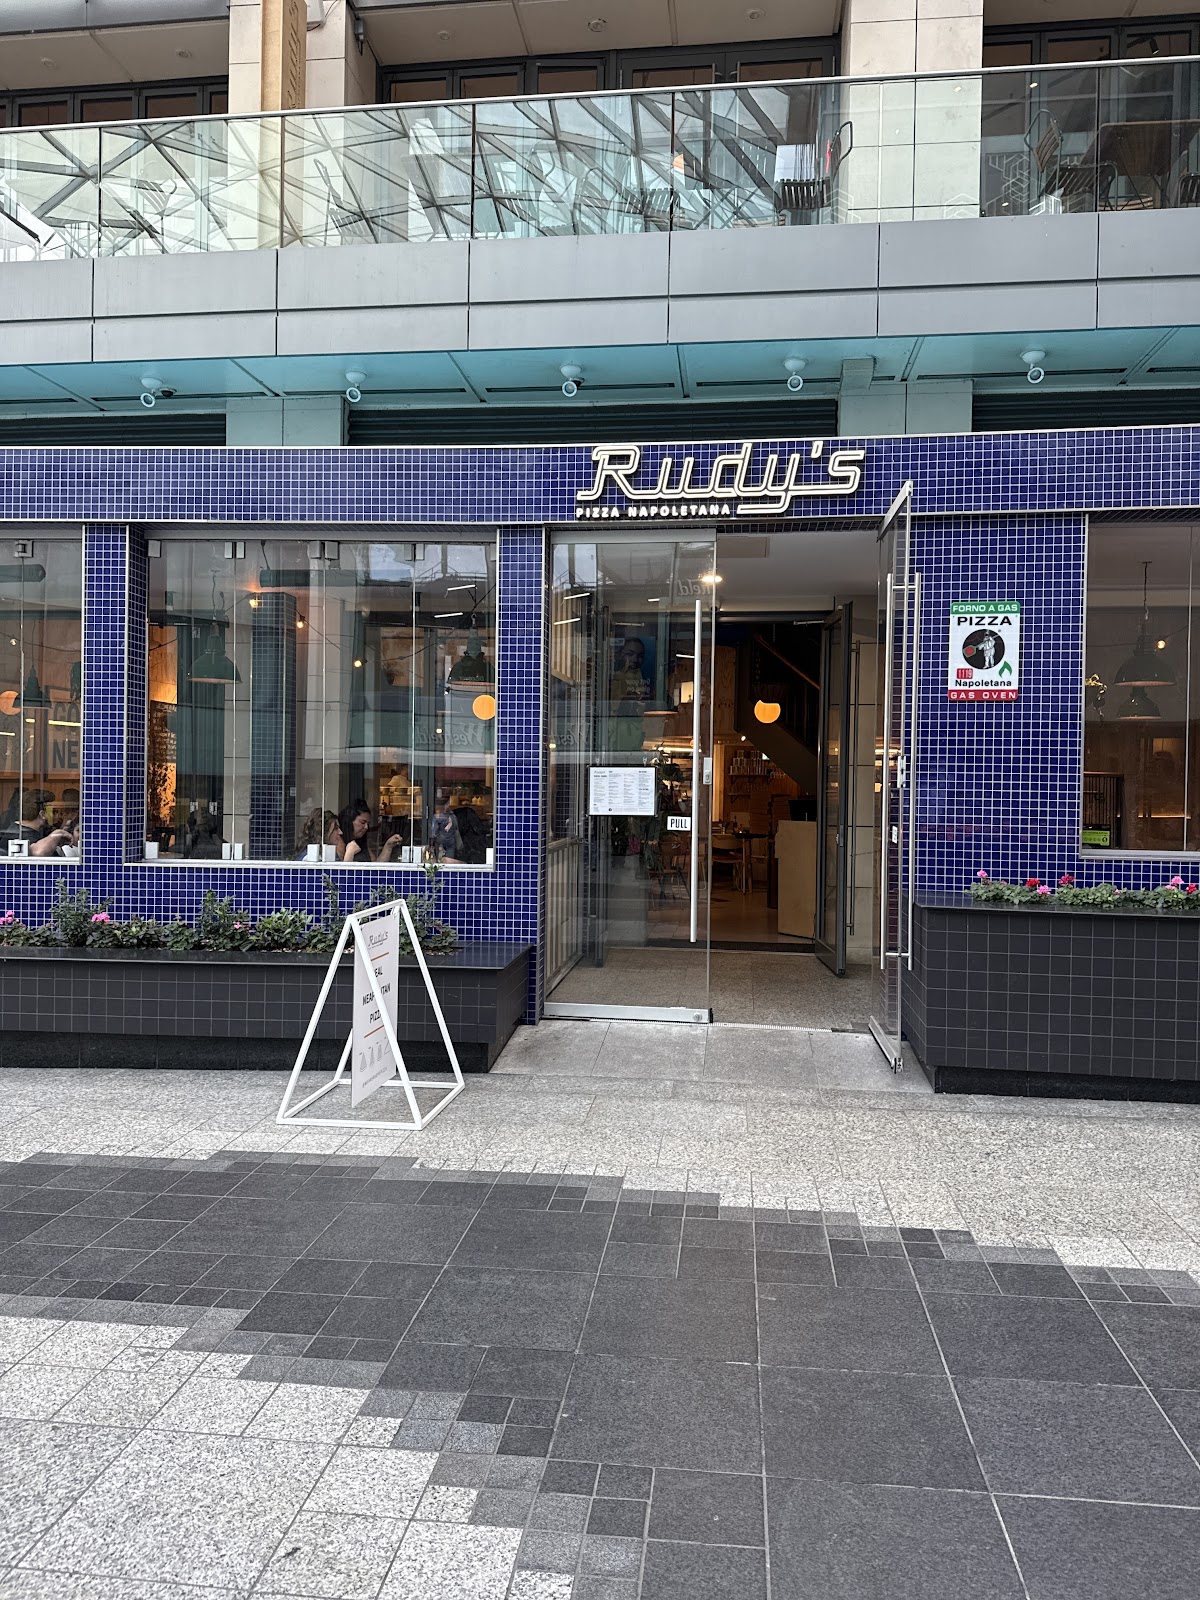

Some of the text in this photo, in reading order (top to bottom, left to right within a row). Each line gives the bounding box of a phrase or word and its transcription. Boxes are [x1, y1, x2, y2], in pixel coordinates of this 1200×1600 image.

[576, 440, 865, 515] Rudy's
[576, 504, 730, 518] PIZZA NAPOLETANA
[988, 604, 995, 612] A
[997, 604, 1018, 612] GAS
[957, 616, 1012, 626] PIZZA
[955, 679, 1012, 688] Napoletana
[670, 818, 688, 829] PULL
